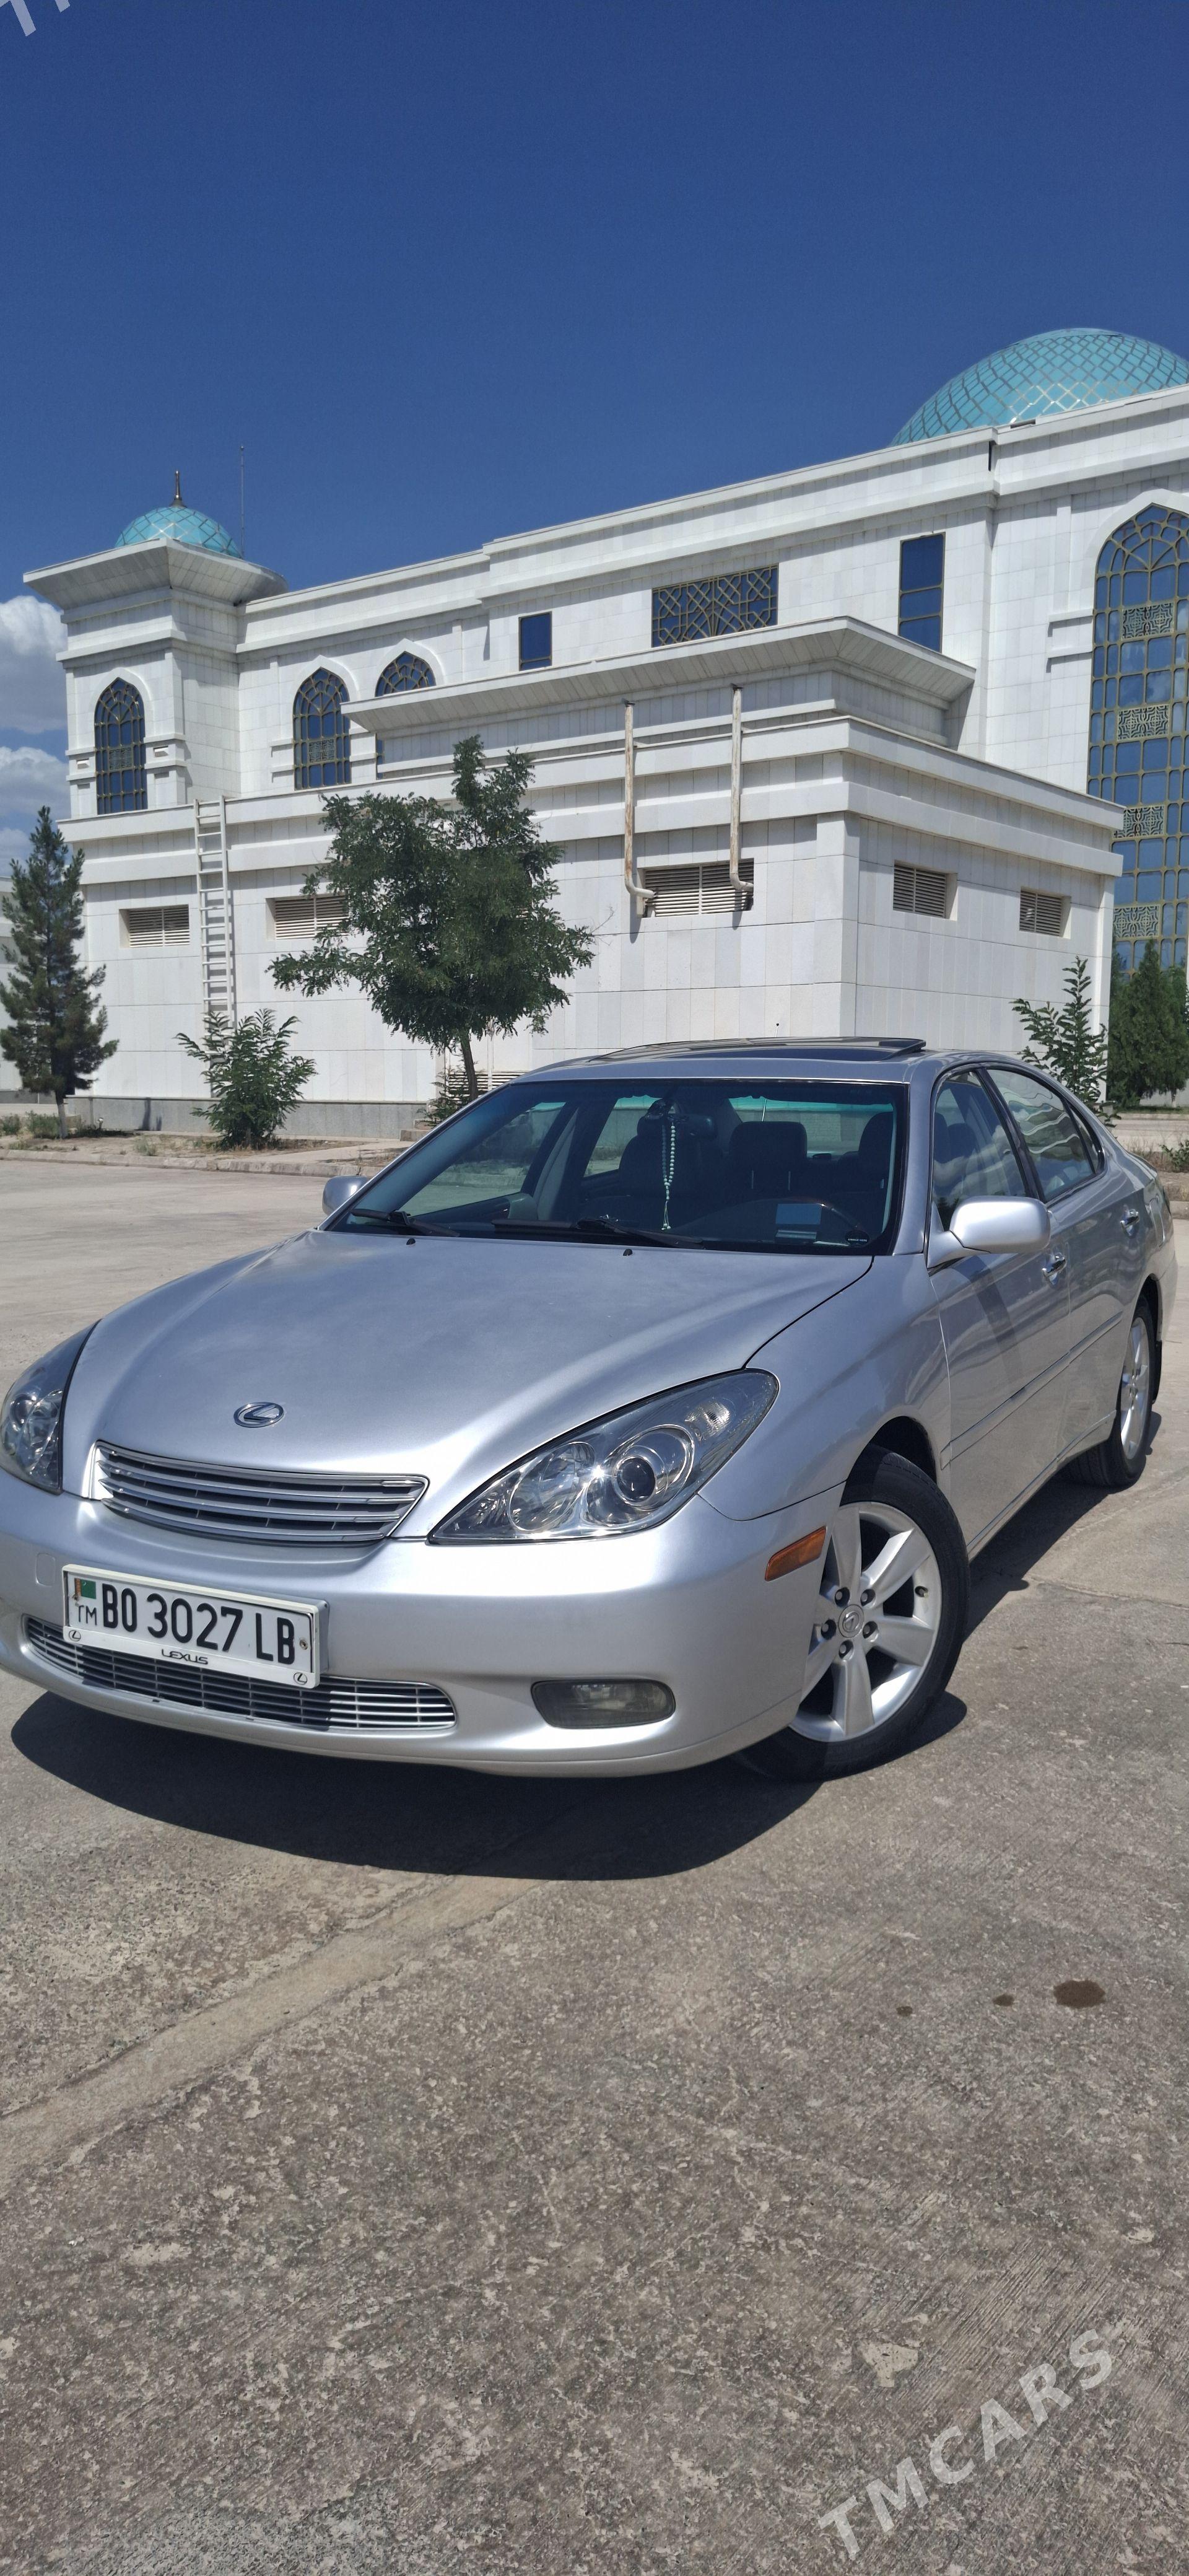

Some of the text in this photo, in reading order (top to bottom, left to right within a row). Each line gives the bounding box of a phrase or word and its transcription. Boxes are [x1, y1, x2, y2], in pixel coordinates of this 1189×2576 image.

[77, 1605, 97, 1626] TM
[147, 1593, 243, 1653] 3027
[255, 1613, 295, 1665] LB
[162, 1649, 208, 1665] LEXUS
